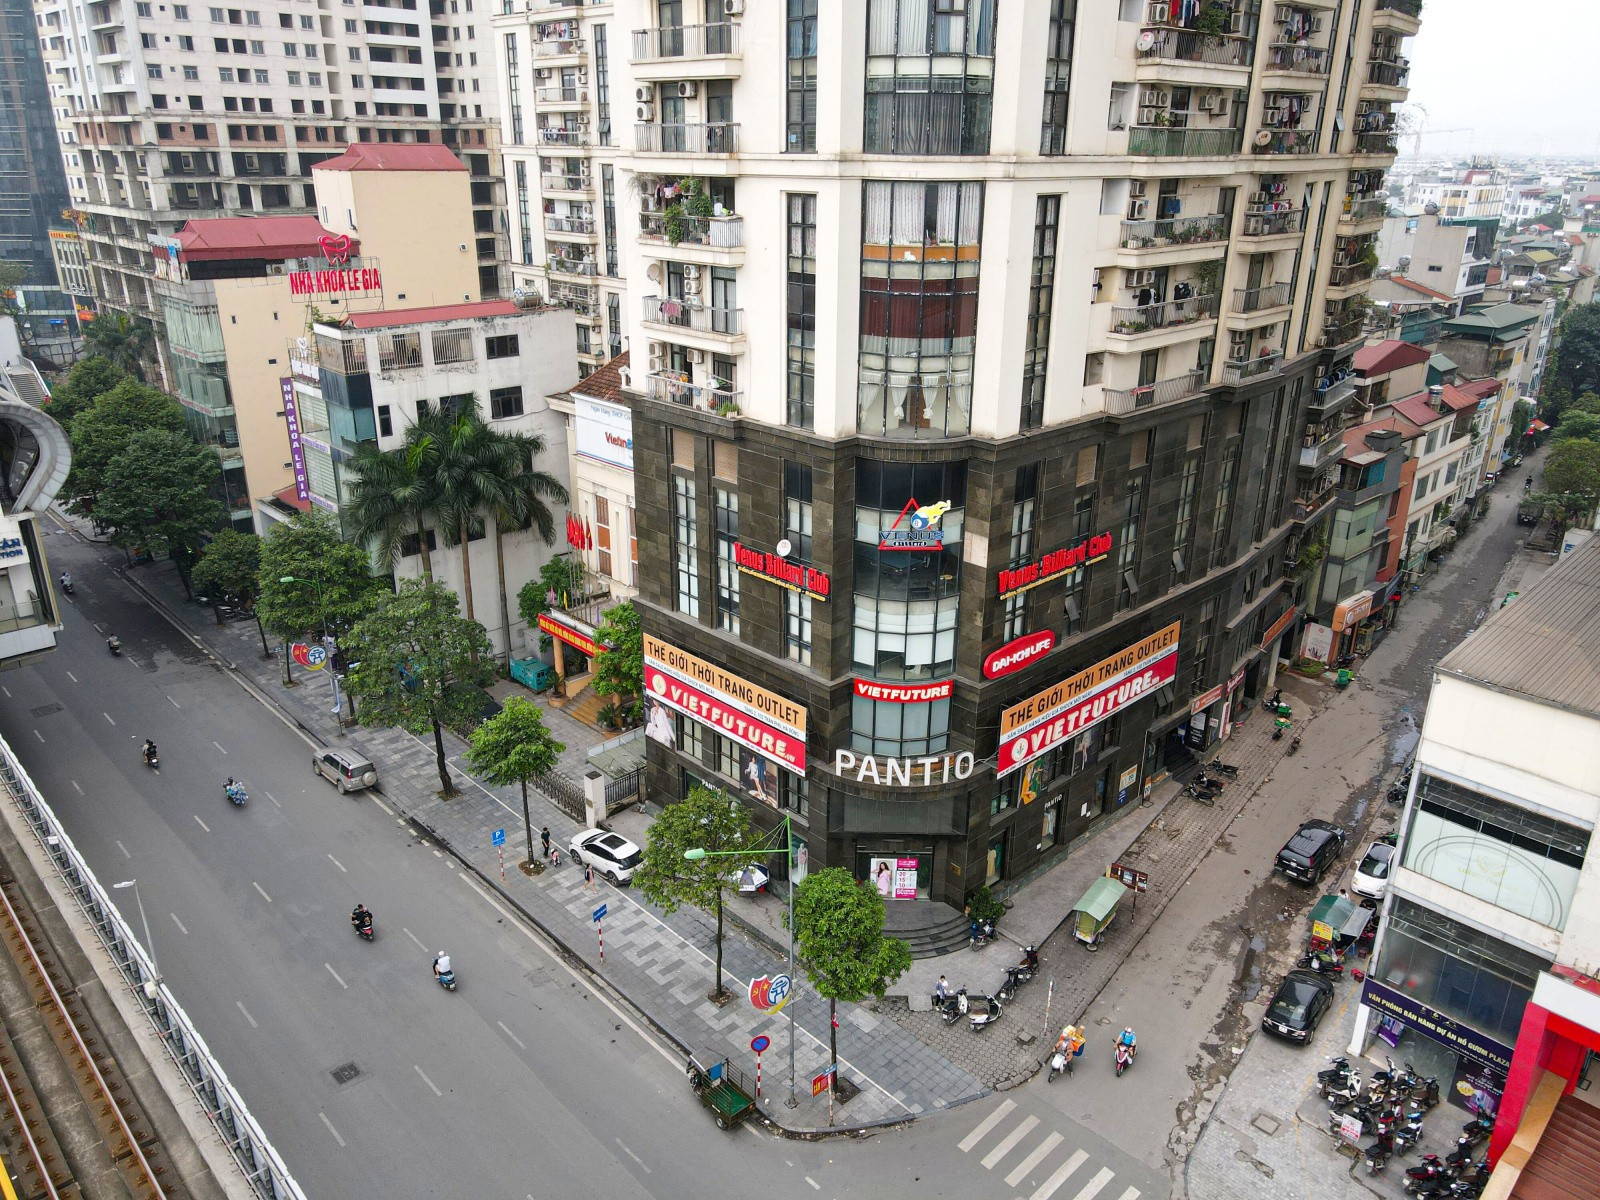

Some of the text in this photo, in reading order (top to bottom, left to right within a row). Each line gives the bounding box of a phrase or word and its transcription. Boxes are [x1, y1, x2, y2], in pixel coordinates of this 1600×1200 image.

[290, 268, 380, 294] NHA KHOA LE GIA
[283, 384, 307, 498] NHA KHOA LE GIA
[734, 542, 764, 572] Venus
[766, 552, 804, 586] Billiard
[807, 567, 830, 596] Club
[998, 562, 1038, 593] Venus
[1041, 541, 1087, 577] Billiard
[1088, 532, 1112, 556] Club
[1030, 638, 1051, 655] LIFE
[648, 641, 800, 725] THẾ GIỚI THỜI TRANG OUTLET
[858, 684, 950, 700] VIETFUTURE
[1010, 699, 1035, 727] THẾ
[1038, 686, 1063, 712] GIỚI
[1068, 671, 1094, 698] THỜI
[1098, 654, 1134, 680] TRANG
[1137, 629, 1175, 660] OUTLET
[836, 748, 974, 786] PANTIO
[1044, 793, 1063, 811] PANTIO
[1368, 992, 1381, 1003] VĂN
[1382, 999, 1403, 1014] PHÒNG
[1403, 1010, 1417, 1021] BÁN
[1418, 1017, 1436, 1030] HÀNG
[1436, 1026, 1447, 1036] DỰ
[1447, 1031, 1457, 1040] ÁN
[1489, 1053, 1510, 1068] PLAZA
